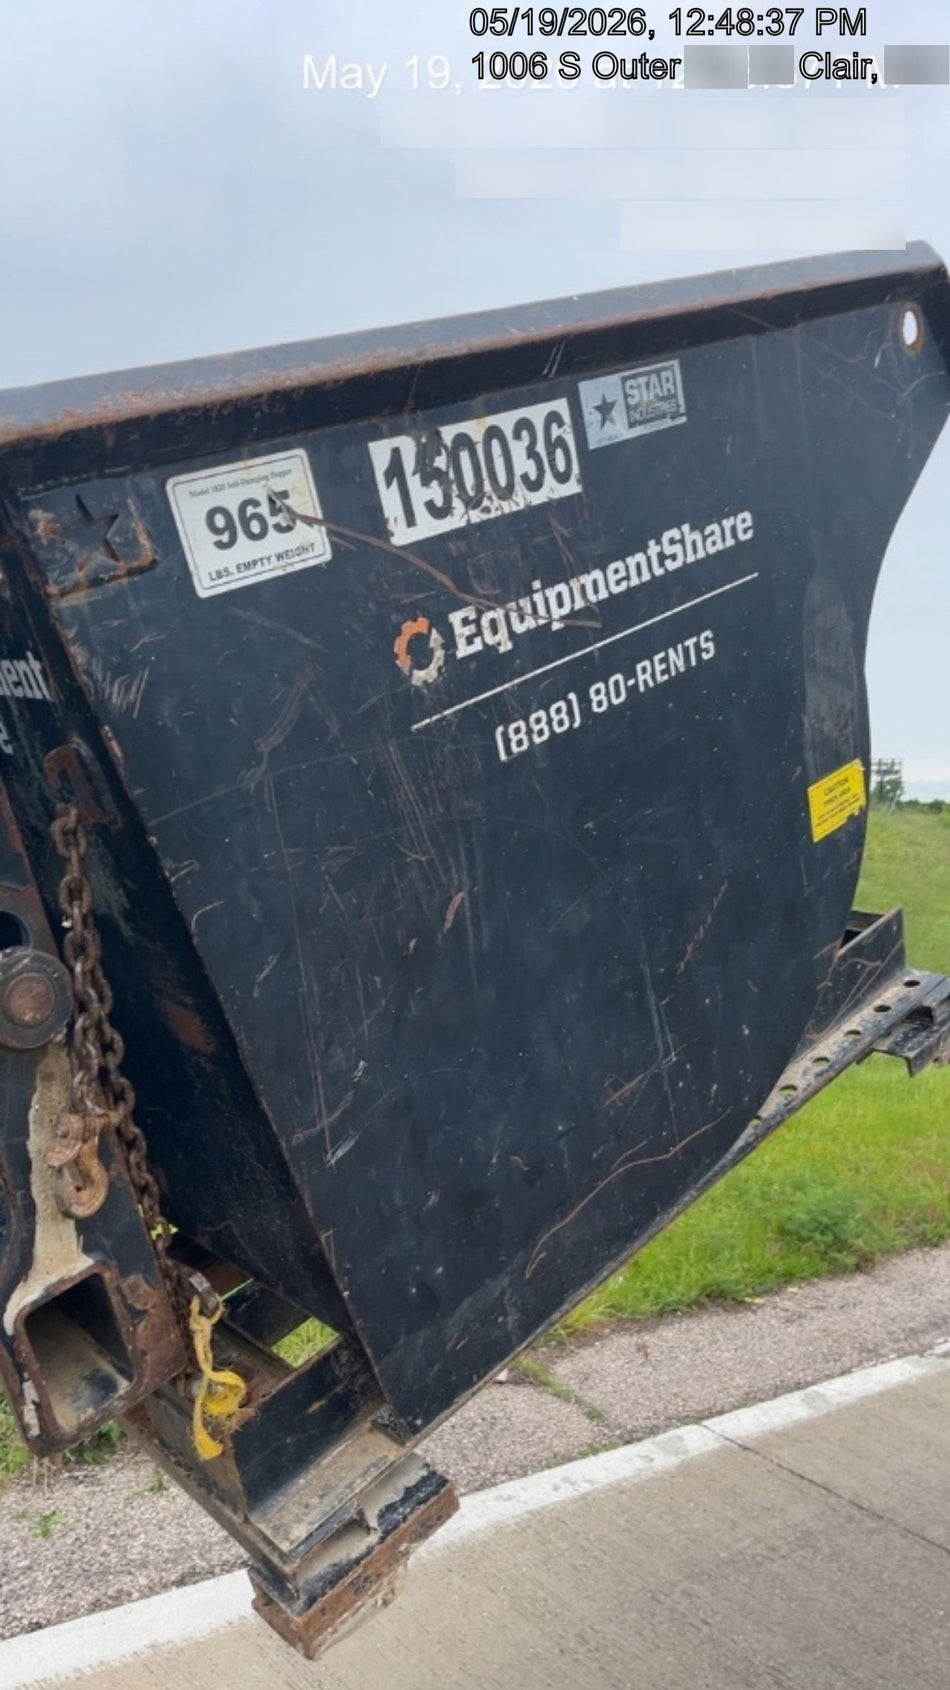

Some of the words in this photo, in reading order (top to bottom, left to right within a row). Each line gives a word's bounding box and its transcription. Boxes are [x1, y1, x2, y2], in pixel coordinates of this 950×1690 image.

[625, 370, 675, 405] STAR
[205, 489, 297, 551] 965
[208, 567, 234, 581] LBS.
[236, 555, 272, 573] EMPTY
[274, 542, 316, 562] WEIGHT
[448, 510, 754, 659] EquipmentShare
[494, 692, 581, 763] (888)
[589, 630, 716, 713] 80-RENTS
